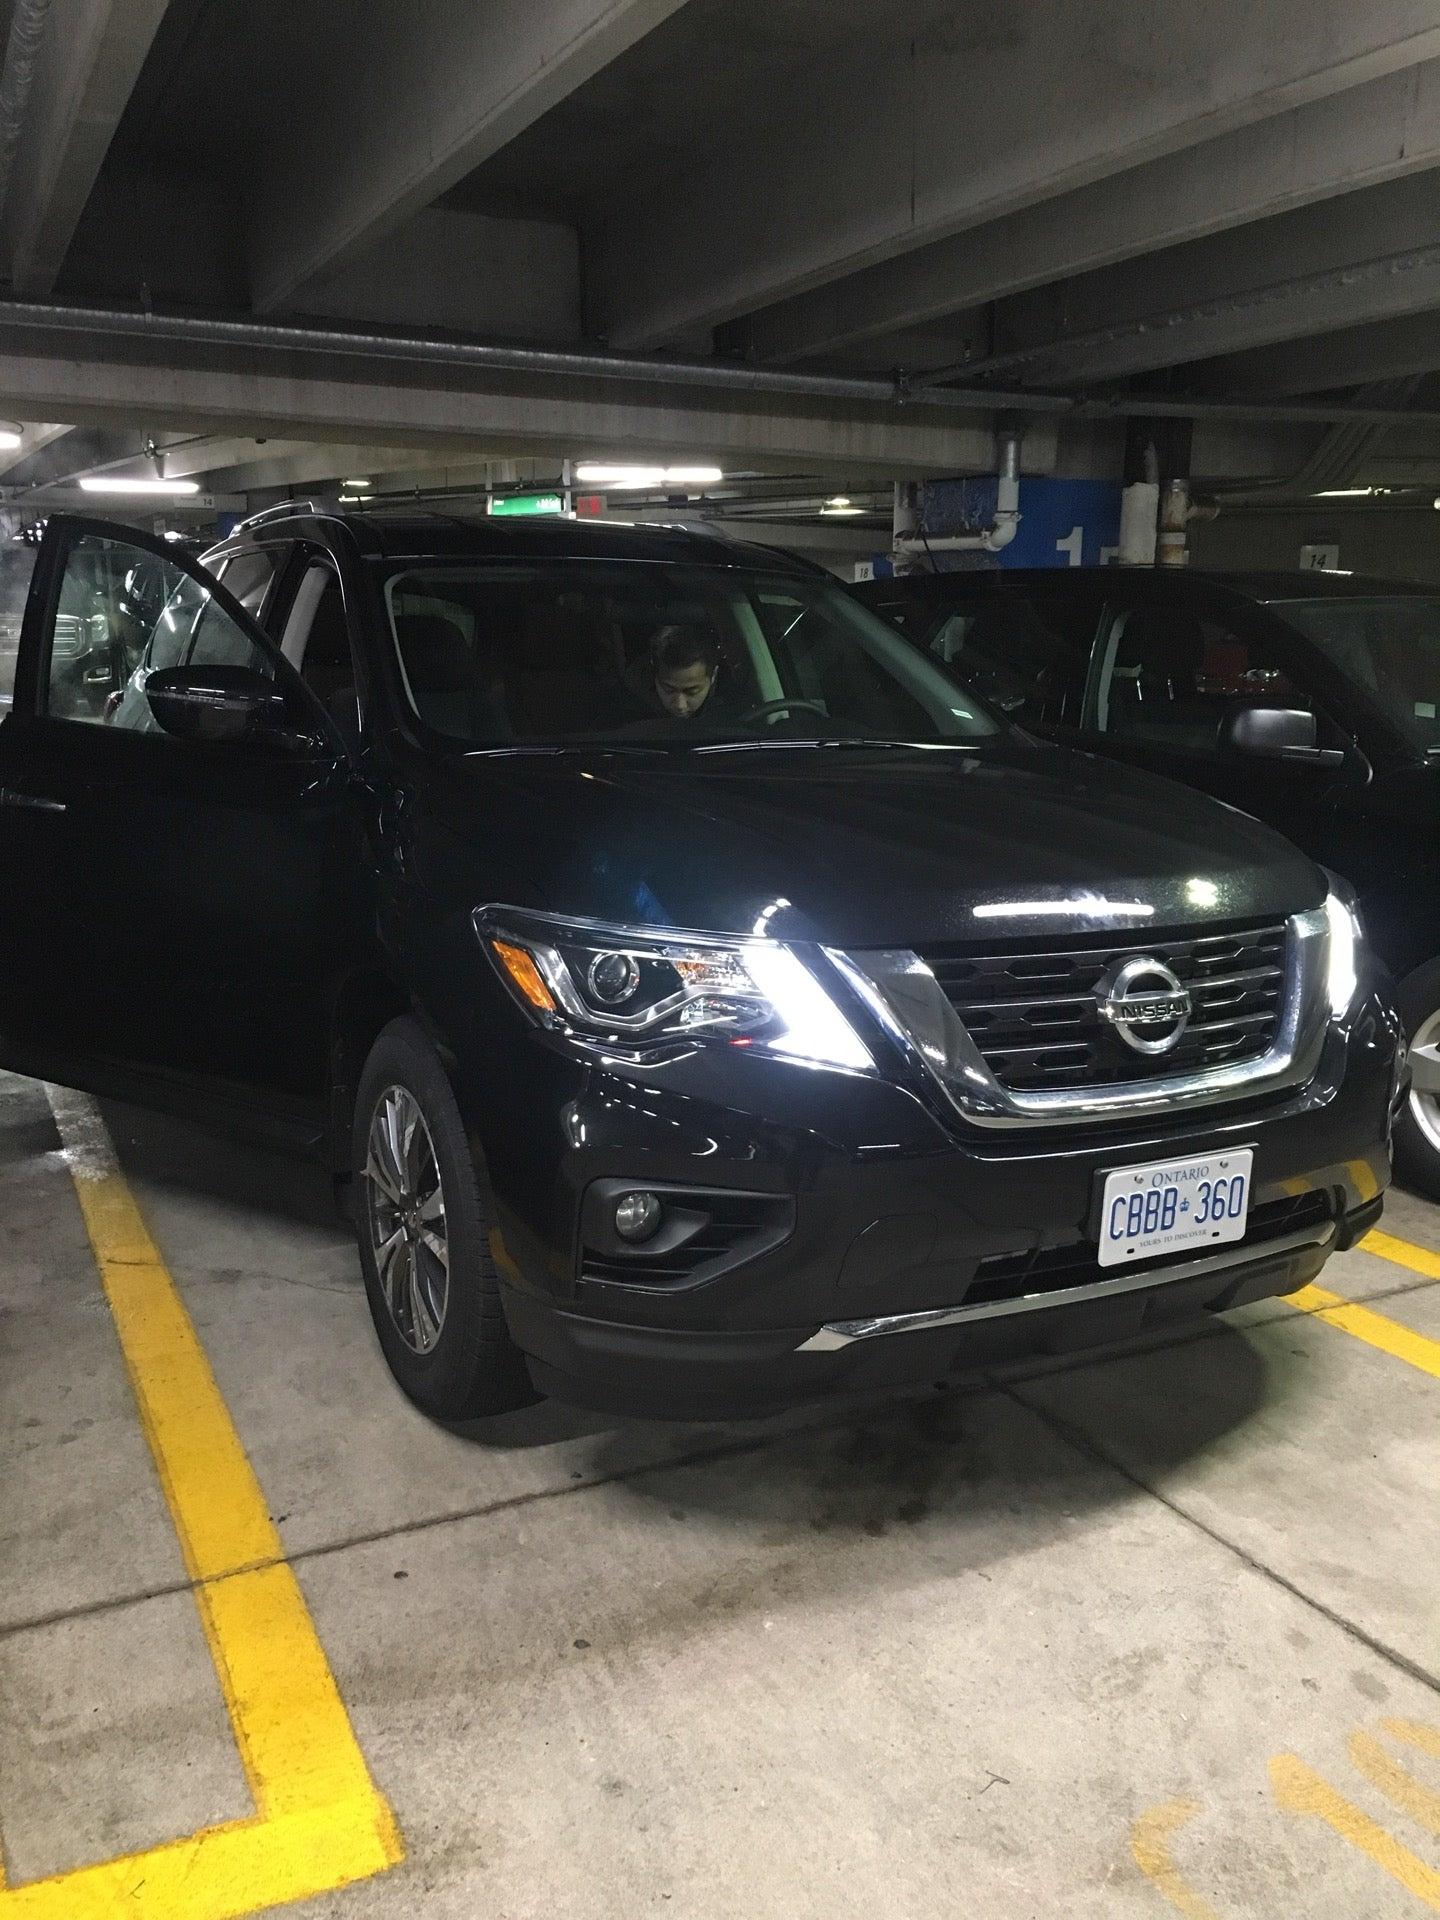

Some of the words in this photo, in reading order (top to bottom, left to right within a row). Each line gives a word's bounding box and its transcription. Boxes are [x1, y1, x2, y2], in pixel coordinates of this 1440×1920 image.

[1310, 553, 1327, 569] 14
[860, 567, 869, 579] 18
[1120, 1001, 1190, 1018] NISSAN
[1109, 1186, 1179, 1241] CBBB
[1194, 1175, 1245, 1224] 360
[1139, 1236, 1162, 1248] YOURS
[1164, 1233, 1174, 1243] TO
[1174, 1228, 1208, 1241] DISCOVER
